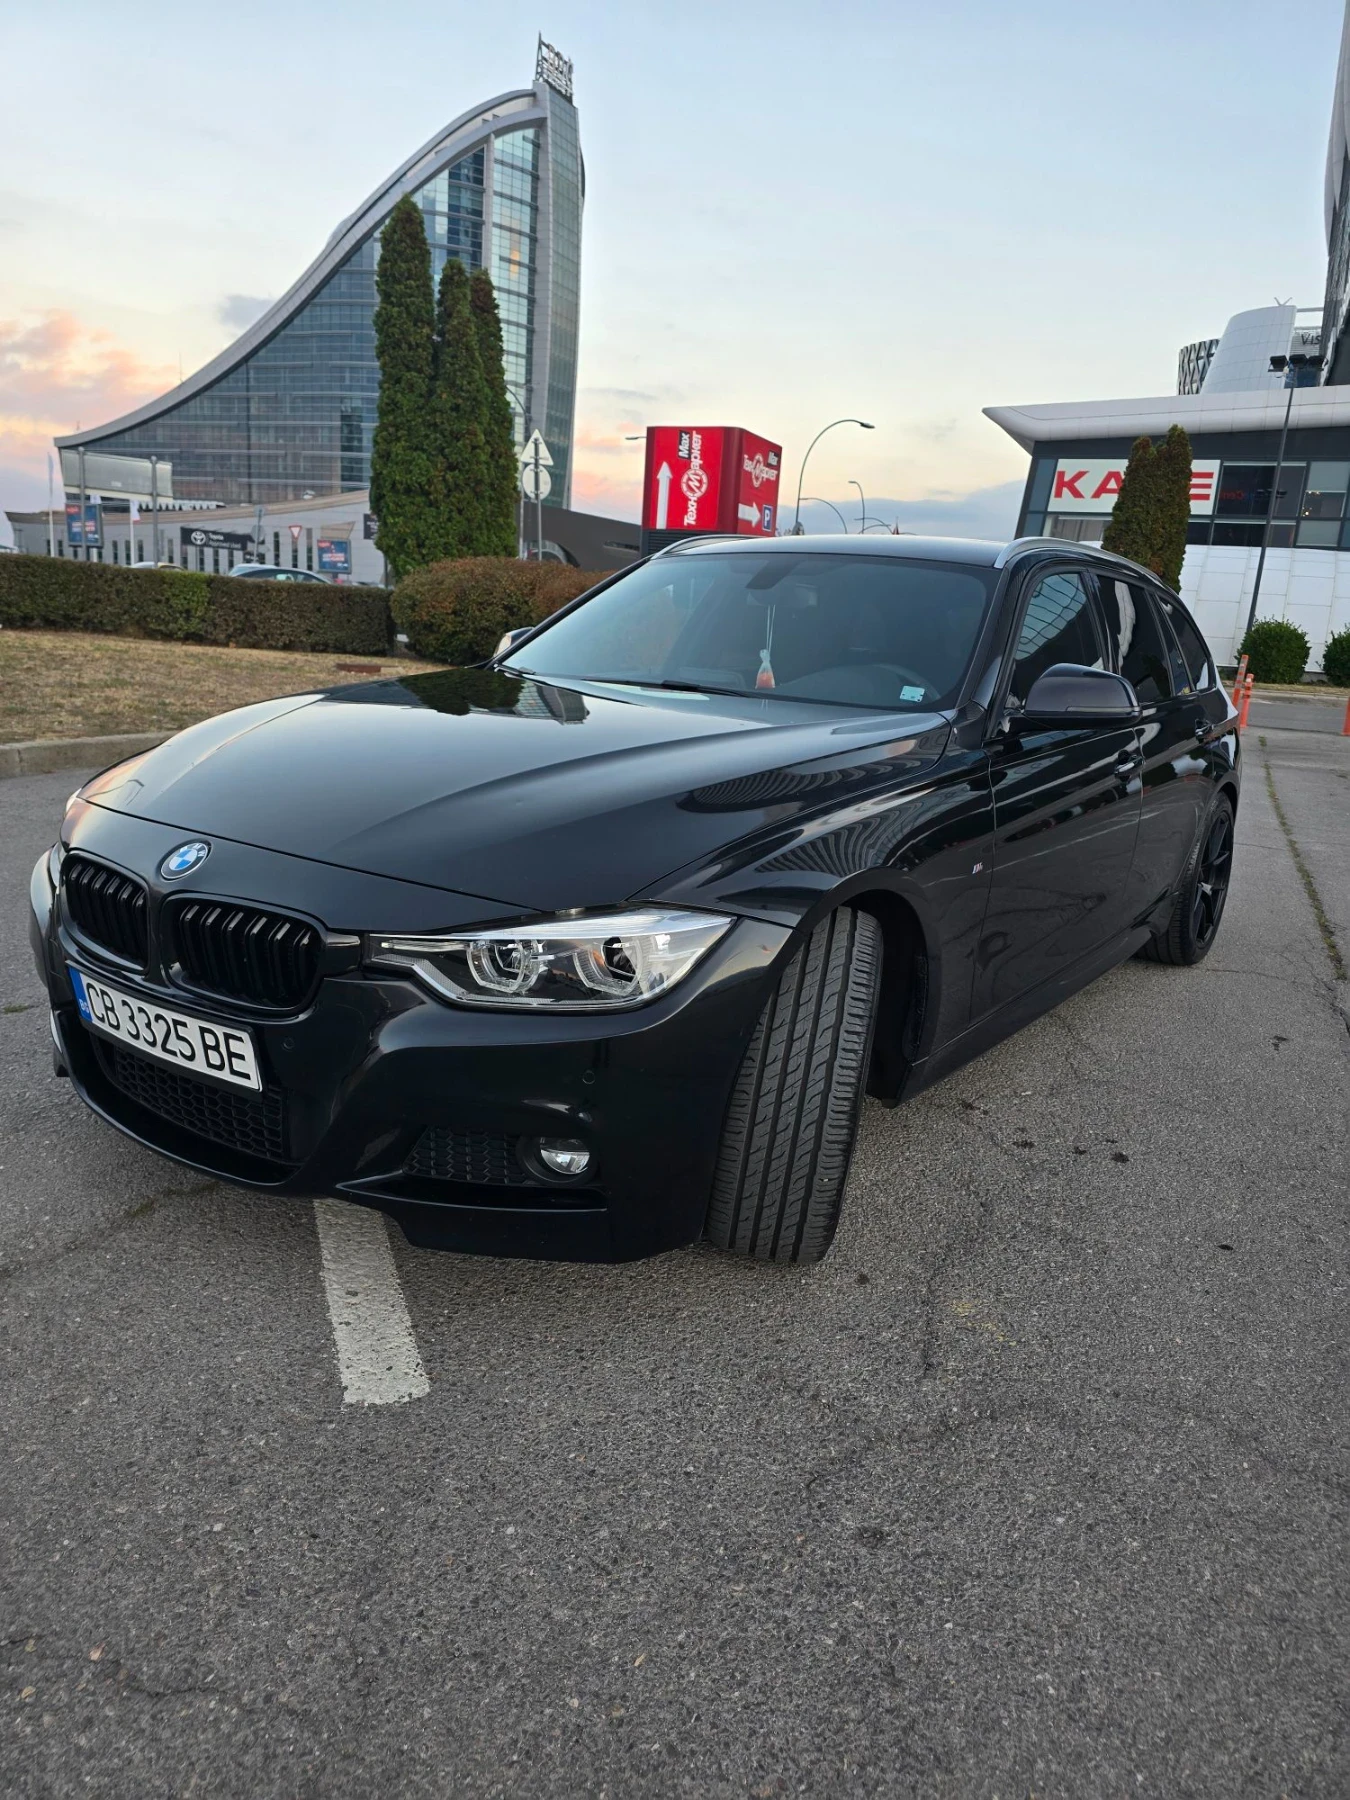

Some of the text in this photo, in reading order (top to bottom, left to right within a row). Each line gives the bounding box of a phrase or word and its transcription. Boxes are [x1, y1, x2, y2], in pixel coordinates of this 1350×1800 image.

[679, 432, 690, 458] Max
[1053, 470, 1214, 501] KAE
[764, 509, 771, 527] P
[78, 999, 90, 1014] BG
[86, 982, 251, 1081] CB 3325 BE
